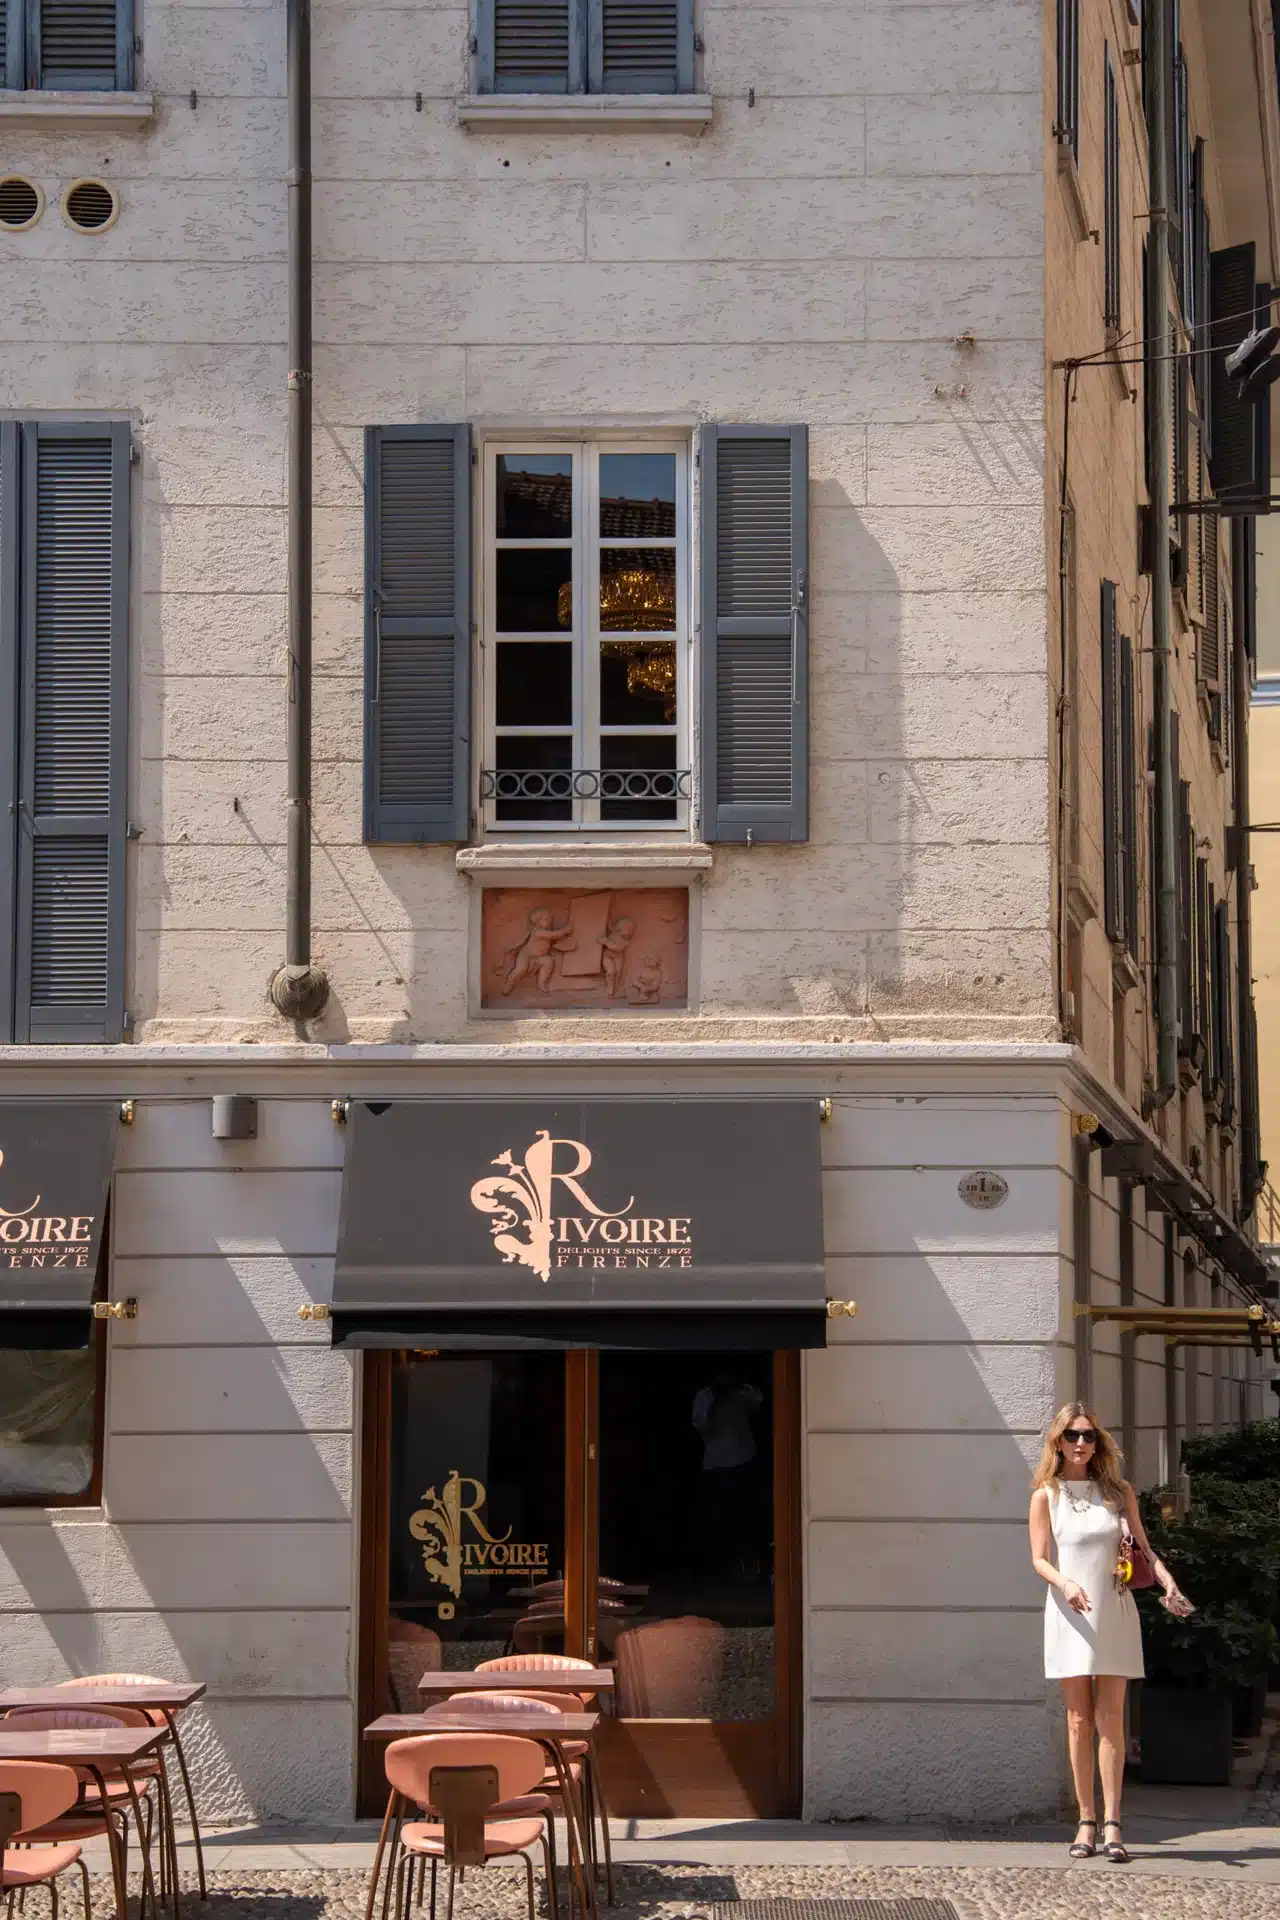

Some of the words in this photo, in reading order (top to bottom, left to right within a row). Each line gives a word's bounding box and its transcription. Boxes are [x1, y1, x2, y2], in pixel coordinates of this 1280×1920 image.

[557, 1247, 620, 1255] DELIGHTS
[624, 1247, 661, 1255] SINCE
[667, 1247, 691, 1255] 1872
[8, 1254, 89, 1268] ENZE
[556, 1255, 692, 1268] FIRENZE
